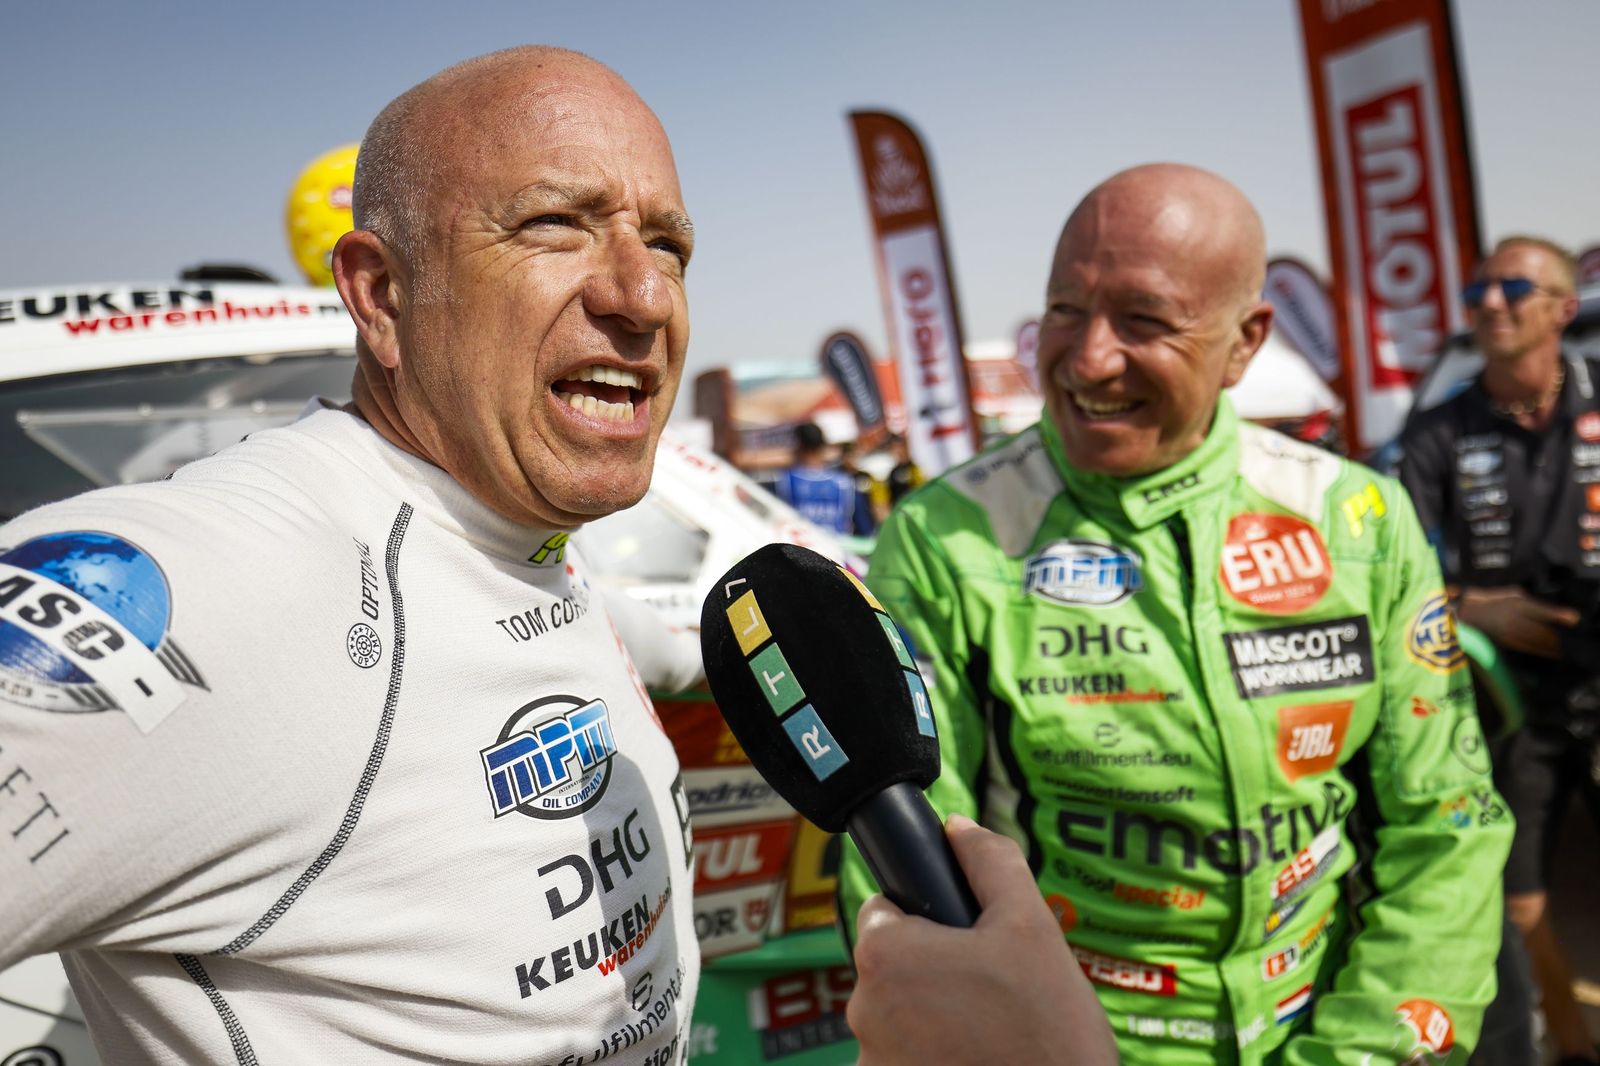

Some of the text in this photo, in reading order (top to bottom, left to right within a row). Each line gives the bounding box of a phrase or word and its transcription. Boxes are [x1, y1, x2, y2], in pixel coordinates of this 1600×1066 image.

[1356, 98, 1442, 374] MOTUL
[352, 536, 380, 621] OPTIMAL
[1221, 528, 1324, 594] ERU
[495, 606, 549, 643] TOM
[1039, 624, 1150, 659] DHG
[1017, 672, 1126, 696] KEUKEN
[1238, 652, 1364, 692] WORKWEAR
[1286, 722, 1336, 763] JBL
[542, 772, 604, 809] OIL COMPANY
[536, 808, 650, 921] DHG
[514, 893, 651, 999] KEUKEN
